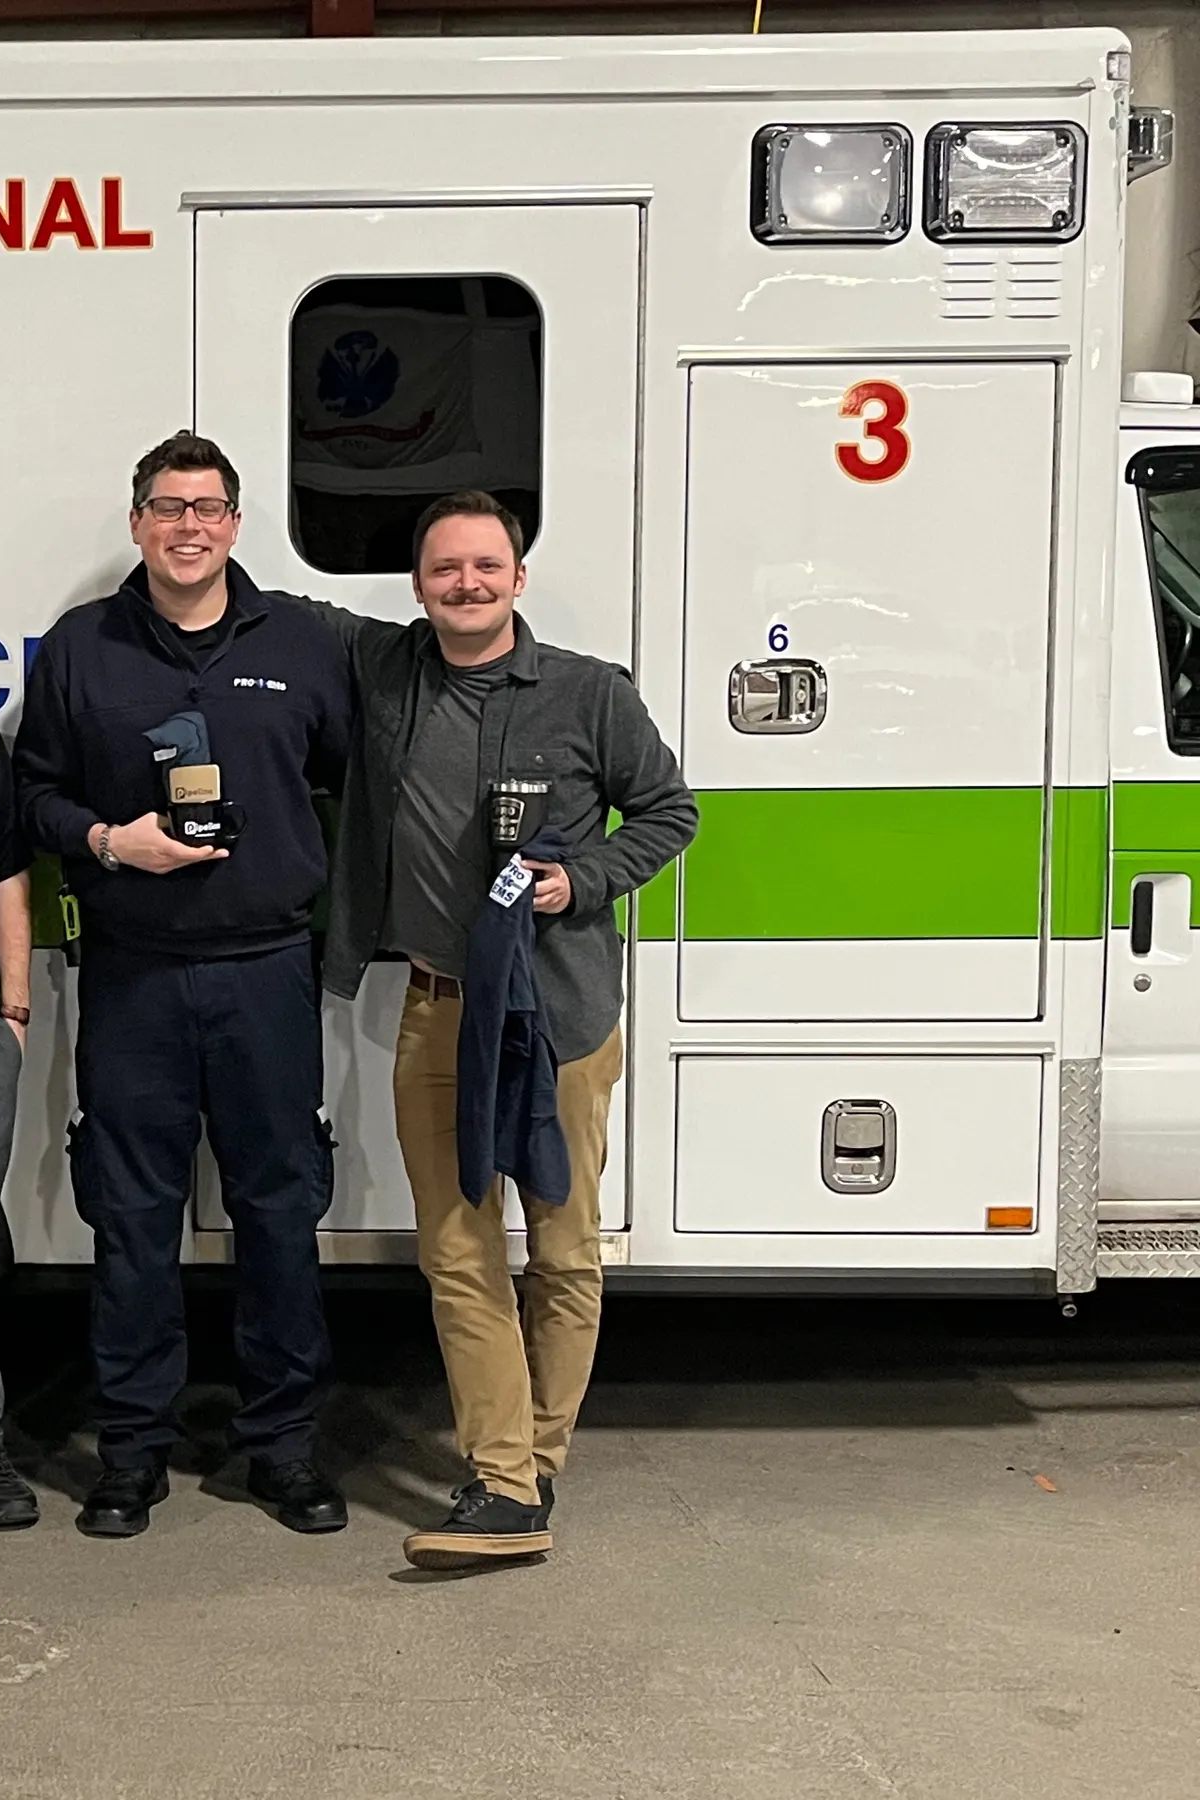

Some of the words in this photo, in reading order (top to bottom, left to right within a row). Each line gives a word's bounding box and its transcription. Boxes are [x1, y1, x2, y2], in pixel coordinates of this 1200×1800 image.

[835, 379, 911, 484] 3
[768, 623, 789, 653] 6
[490, 883, 515, 903] EMS
